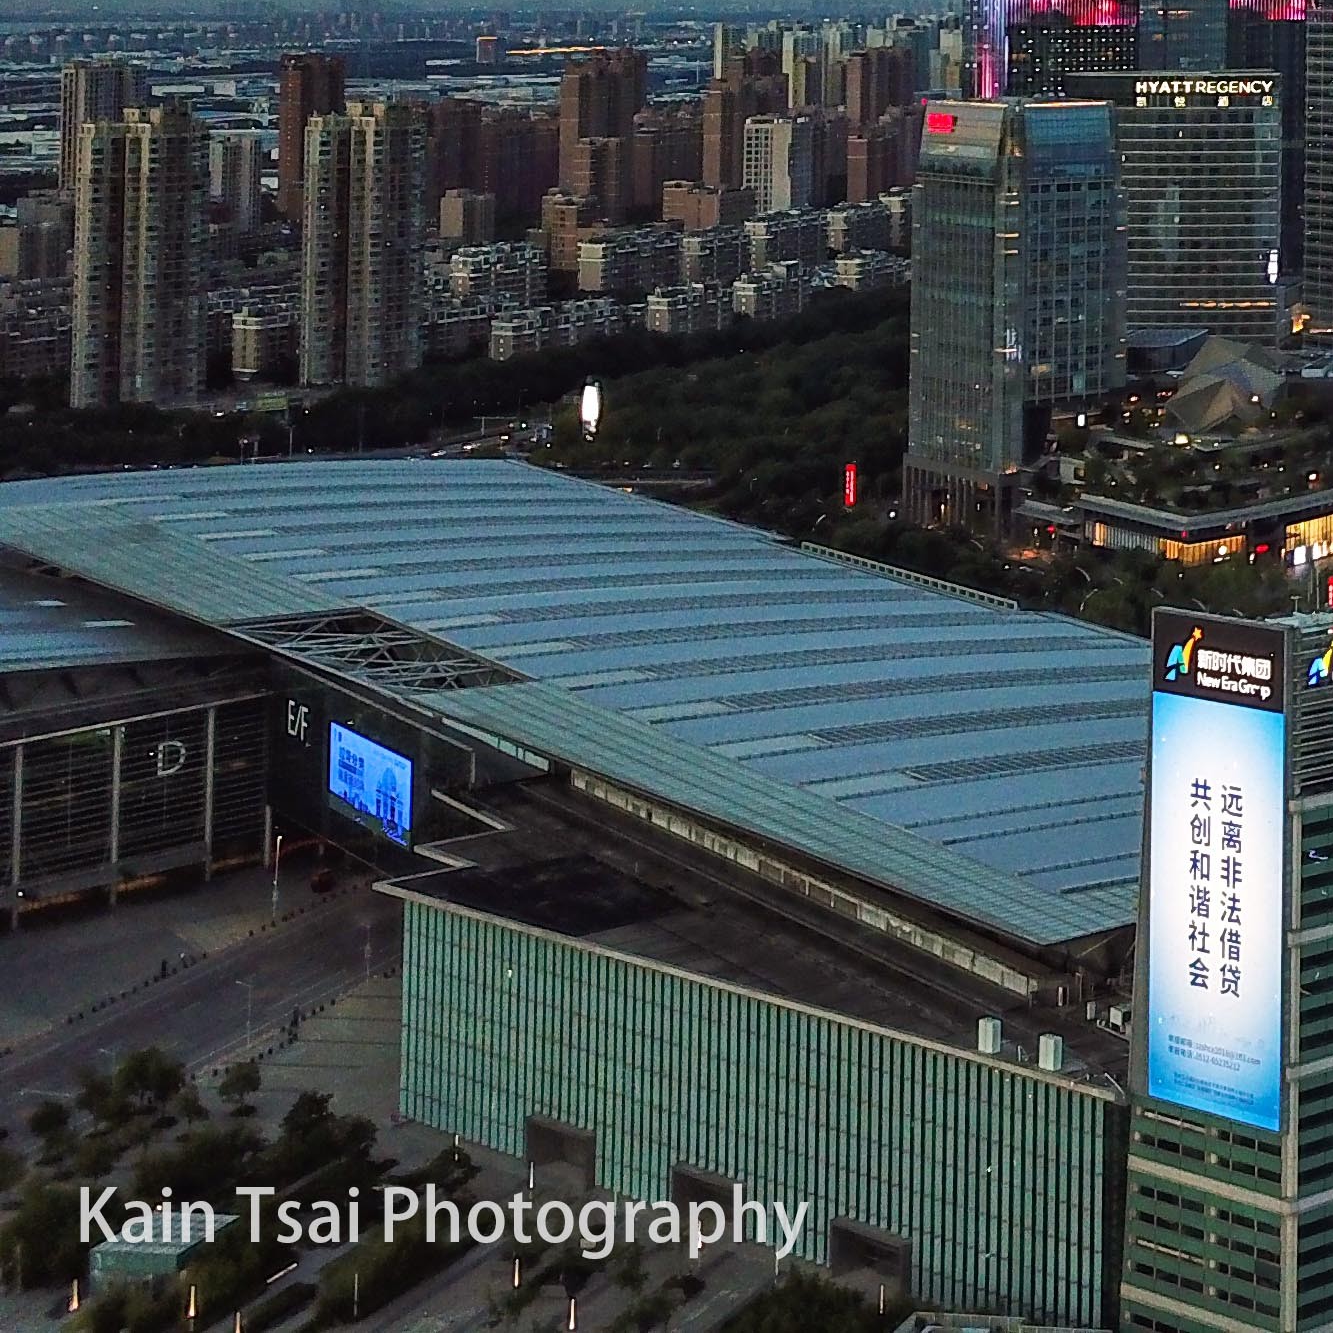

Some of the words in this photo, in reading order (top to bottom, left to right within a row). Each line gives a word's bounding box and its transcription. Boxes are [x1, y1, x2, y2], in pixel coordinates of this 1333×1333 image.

[1136, 81, 1193, 94] HYATT
[1196, 81, 1273, 94] REGENCY
[1197, 648, 1272, 680] 新时代集团
[1197, 671, 1221, 689] New
[1221, 675, 1238, 692] Era
[157, 740, 186, 777] D
[1188, 777, 1212, 990] 共创和谐社会
[1219, 784, 1243, 999] 远离非法借贷
